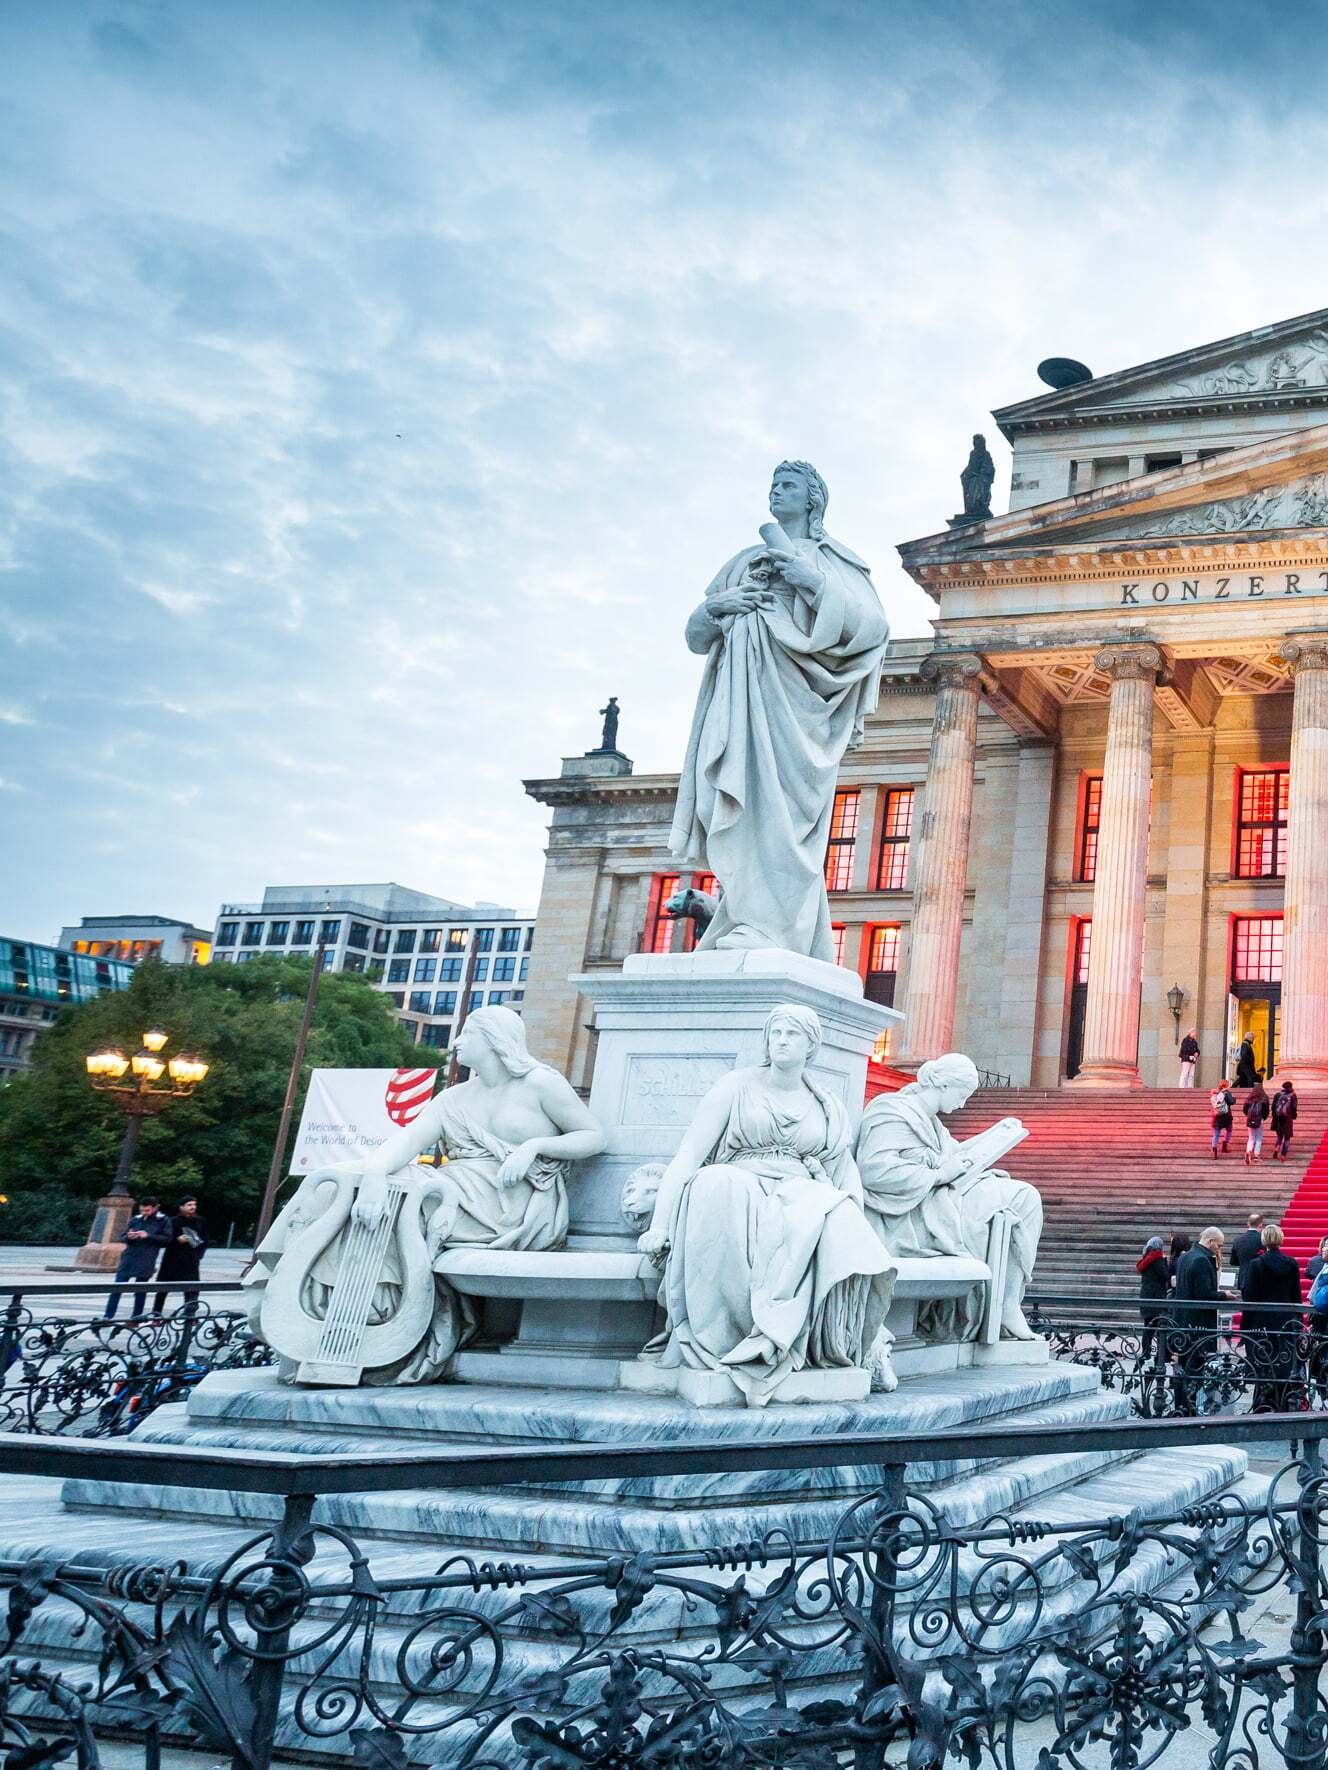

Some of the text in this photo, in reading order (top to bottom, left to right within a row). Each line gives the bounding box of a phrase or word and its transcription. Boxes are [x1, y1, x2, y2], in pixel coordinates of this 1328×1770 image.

[348, 1123, 357, 1132] to
[305, 1135, 318, 1145] the
[321, 1135, 345, 1145] World
